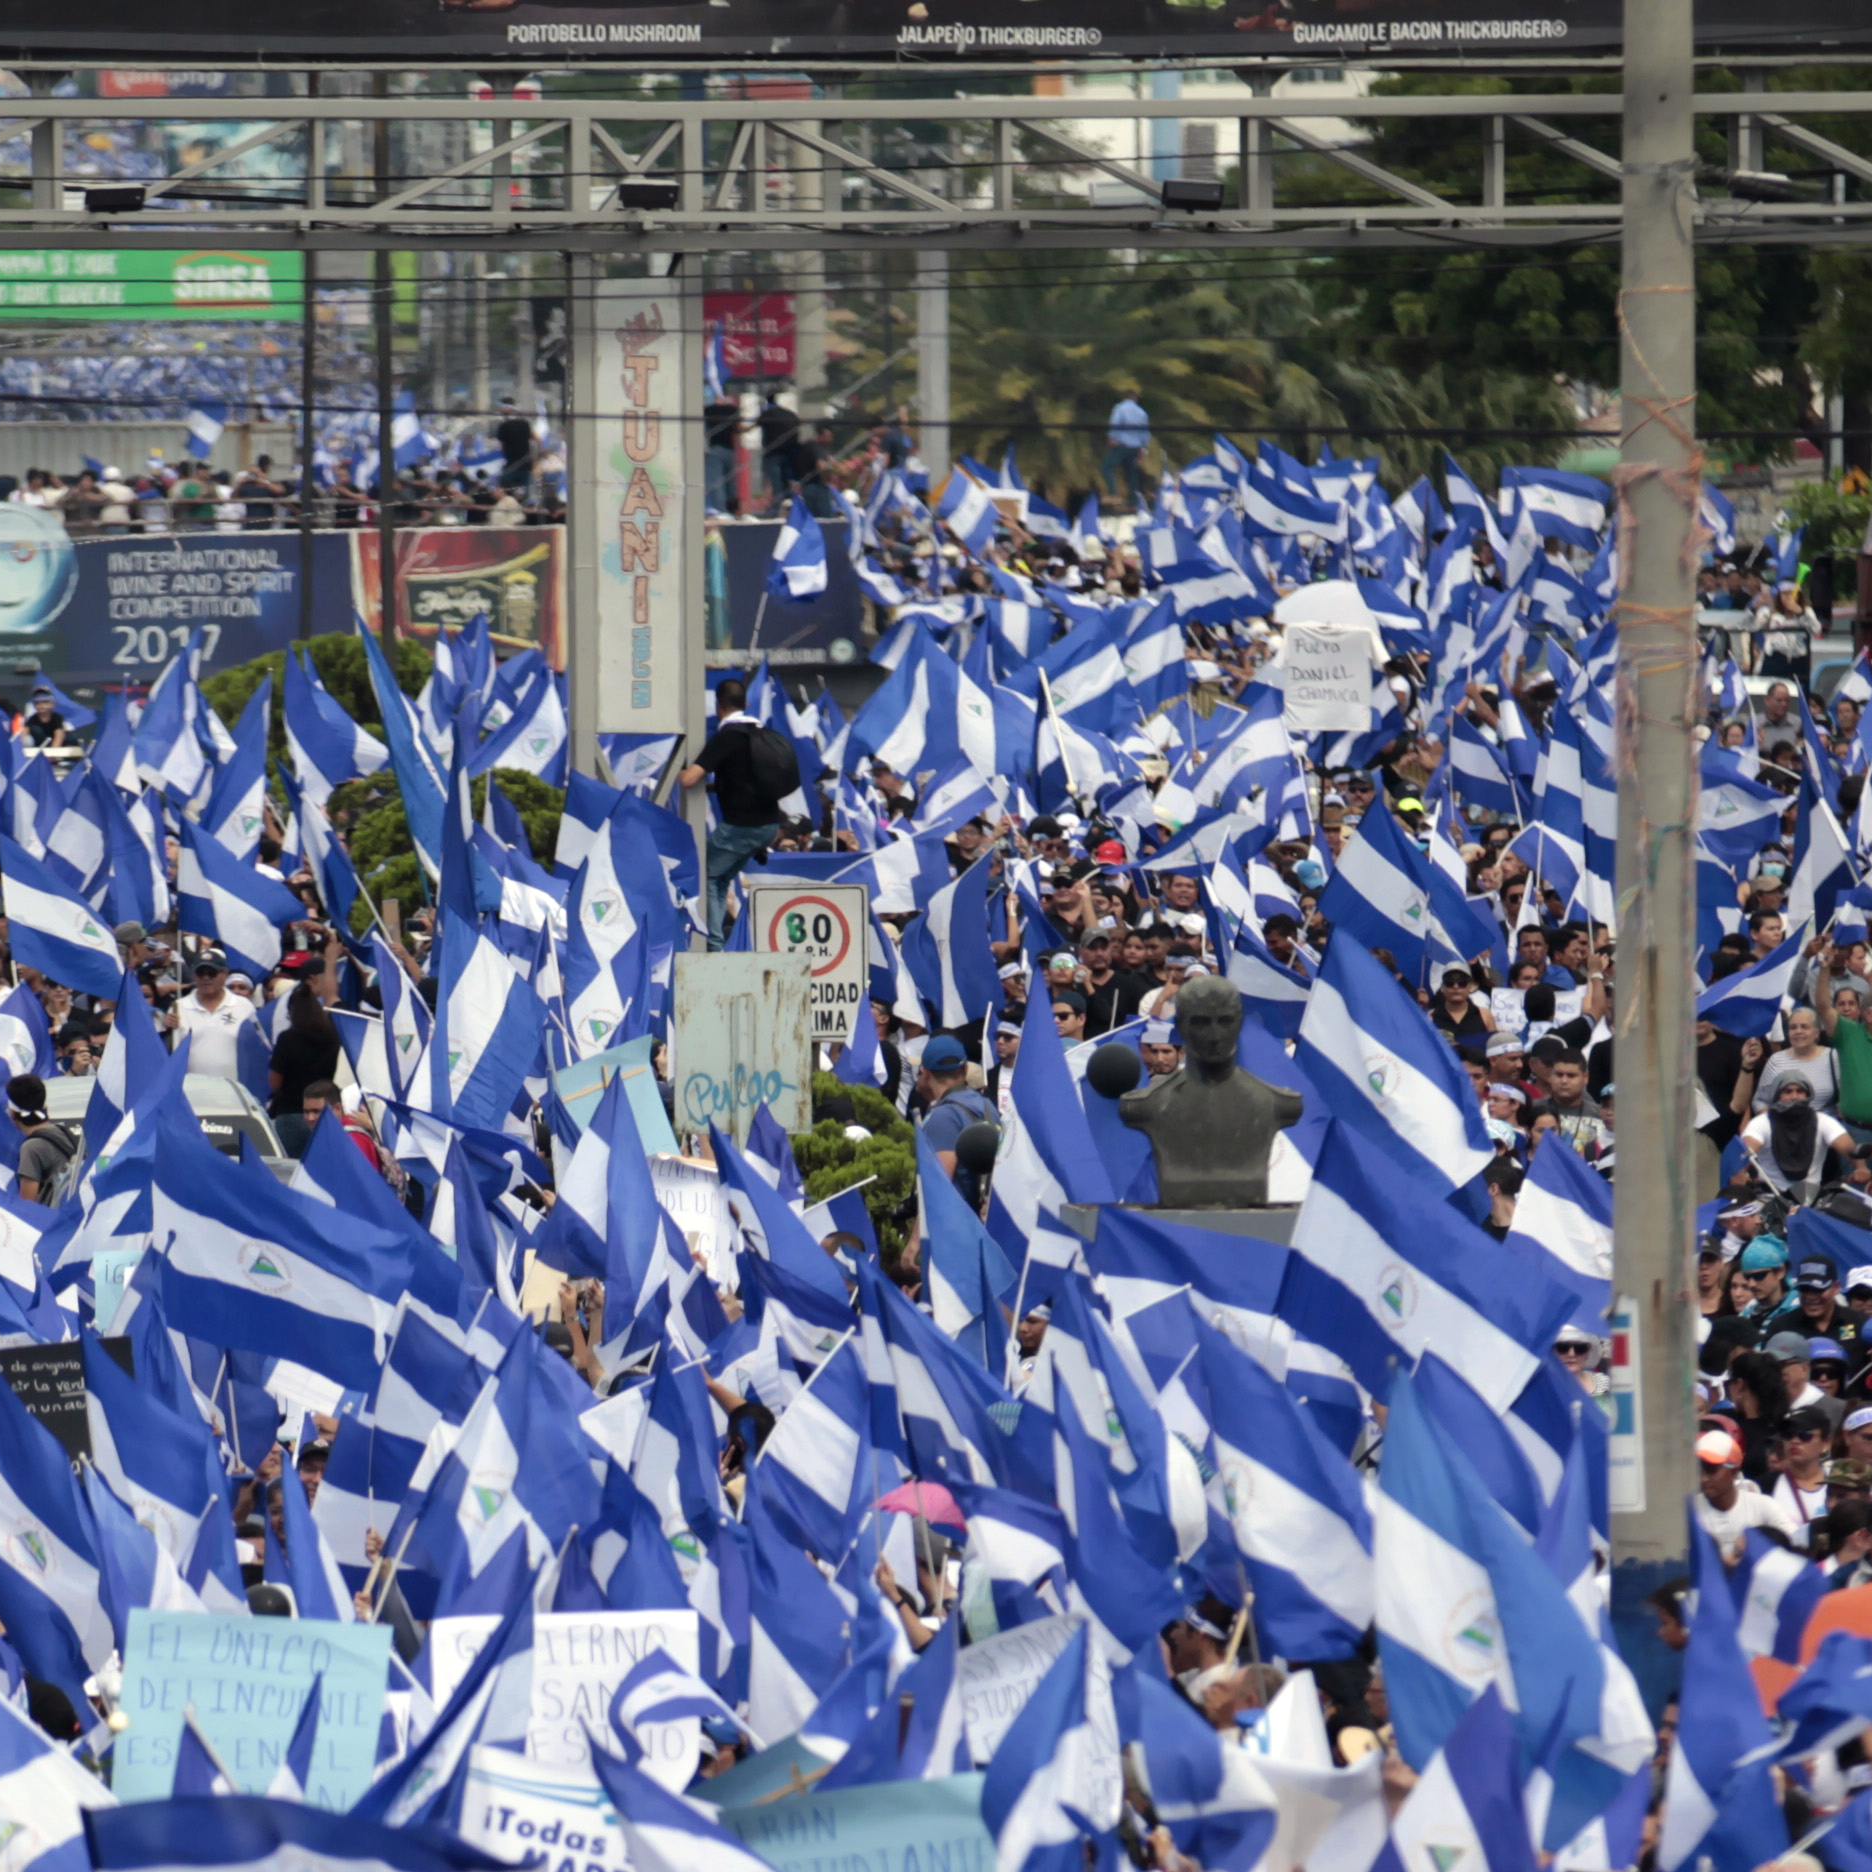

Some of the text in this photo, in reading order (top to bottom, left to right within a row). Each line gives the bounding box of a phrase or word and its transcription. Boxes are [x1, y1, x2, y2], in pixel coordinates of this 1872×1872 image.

[507, 25, 701, 43] PORTOBELLO MUSHROOM
[897, 23, 976, 44] JALAPEÑO
[1294, 22, 1386, 42] GUACAMOLE
[1390, 22, 1442, 40] BACON
[173, 265, 272, 300] SINSA
[620, 355, 663, 624] TUANI
[107, 549, 285, 572] INTERNATIONAL
[107, 571, 296, 595] WINE AND SPIRIT
[109, 596, 263, 618] COMPETITION
[111, 624, 222, 664] 2017
[810, 982, 859, 1005] CIDAD
[814, 1010, 848, 1032] IMA
[147, 1622, 186, 1663] EL
[483, 1803, 607, 1857] ¡Todas
[758, 1805, 838, 1844] RAN
